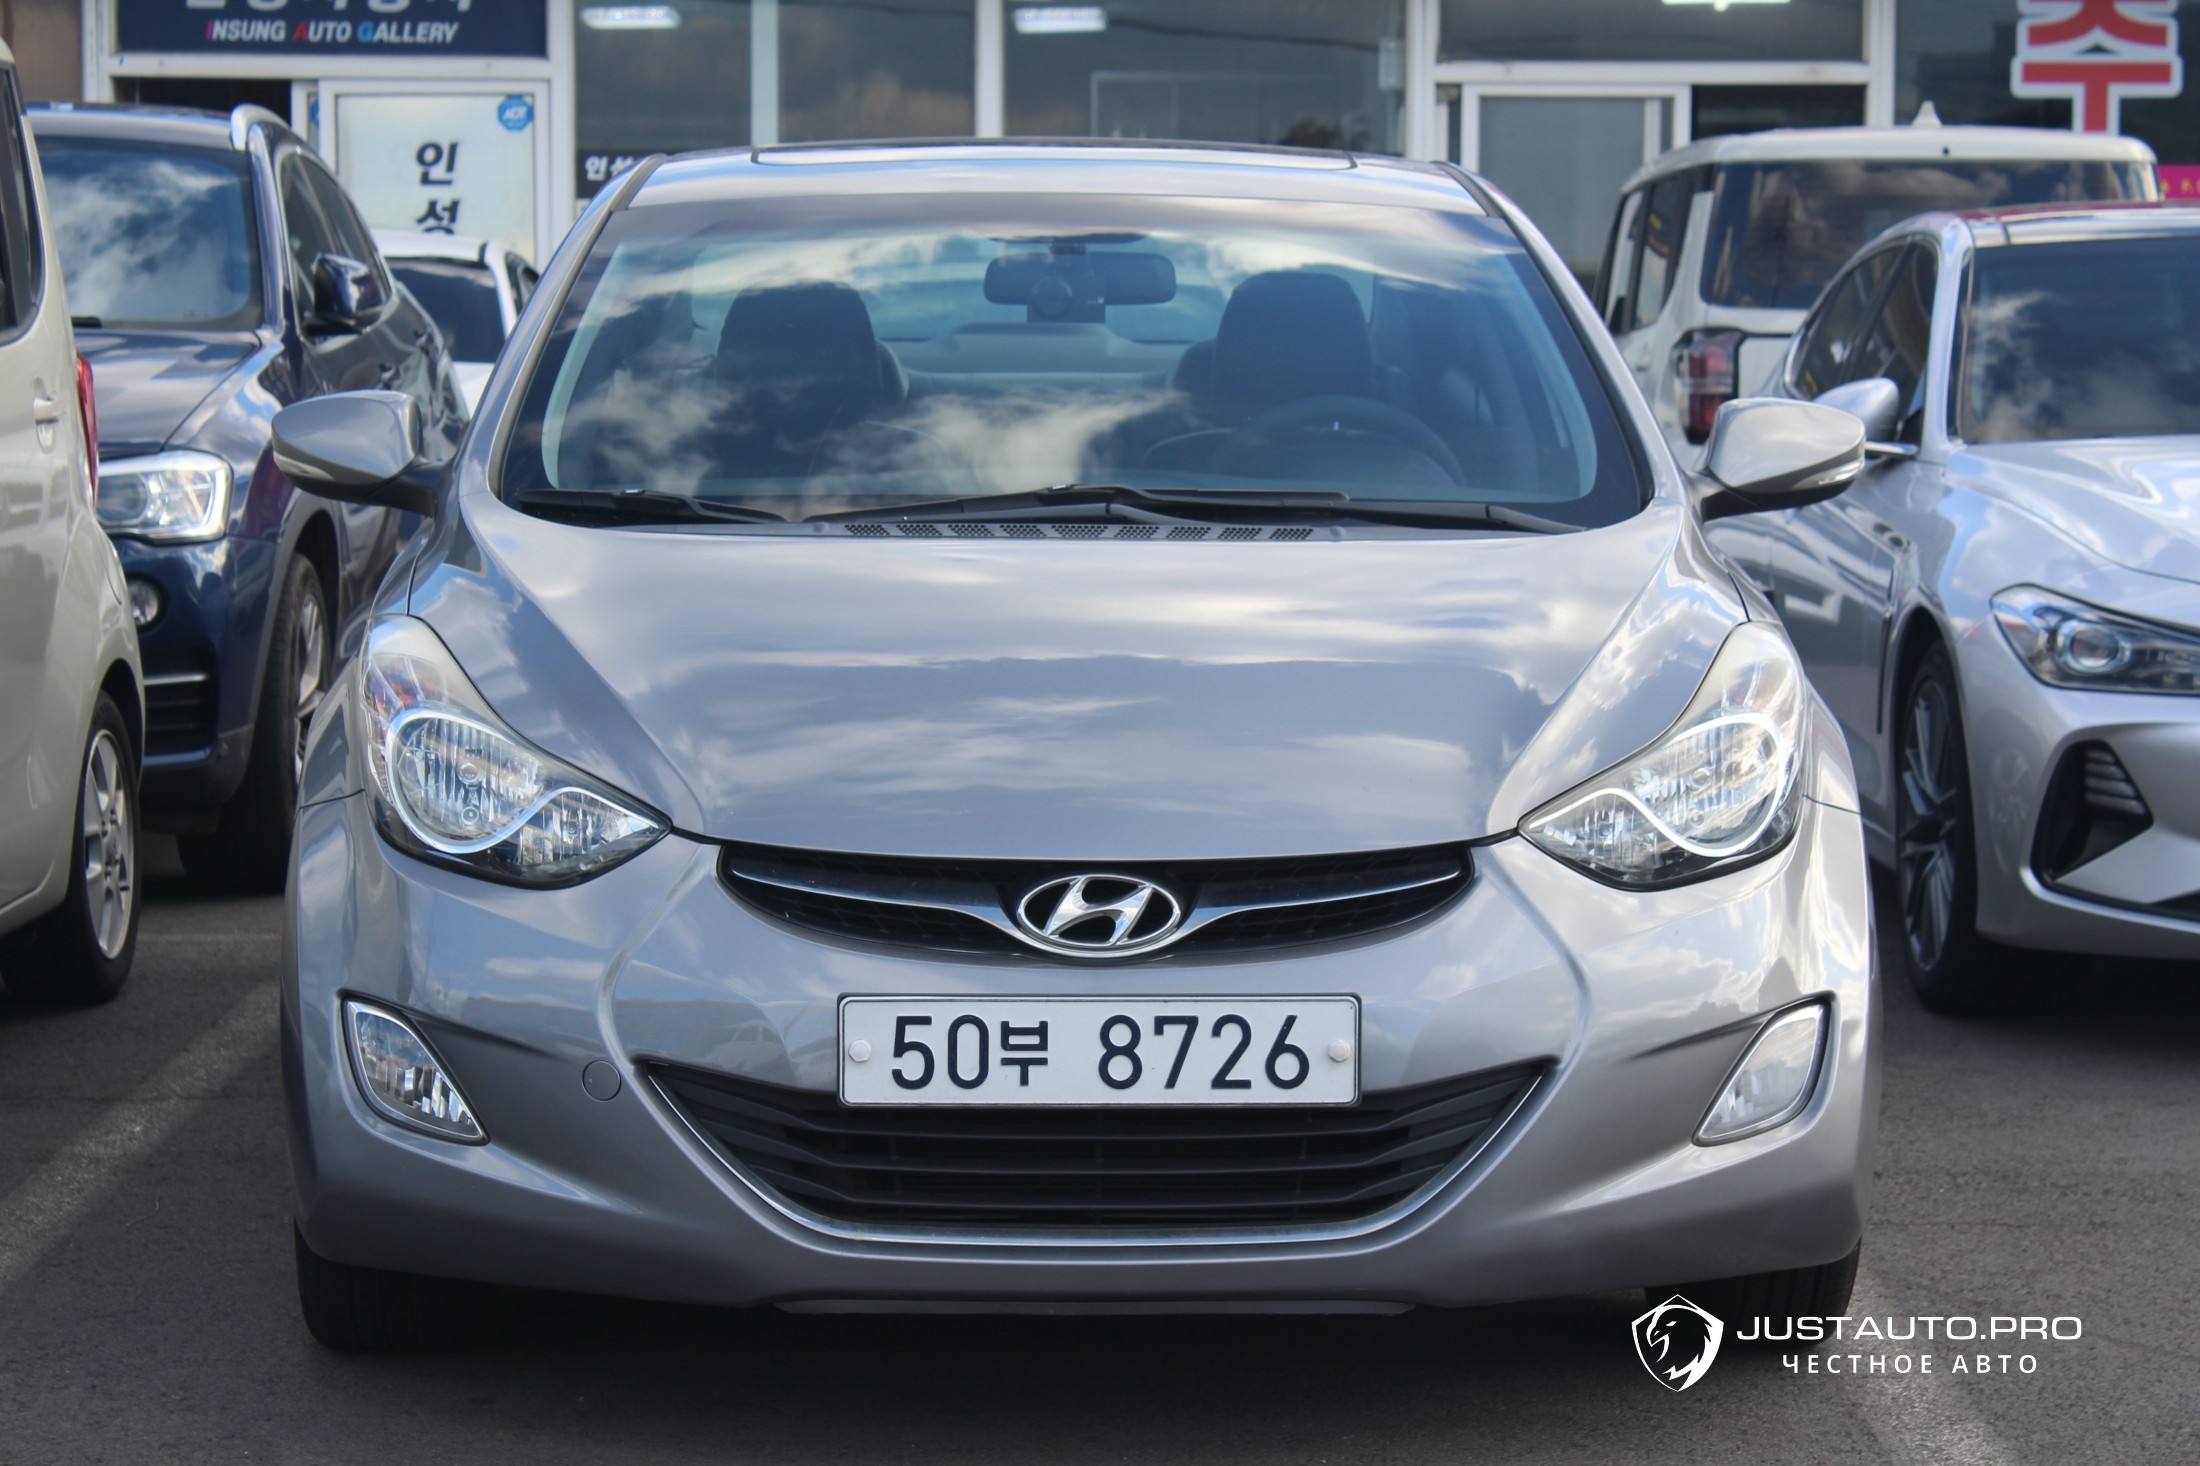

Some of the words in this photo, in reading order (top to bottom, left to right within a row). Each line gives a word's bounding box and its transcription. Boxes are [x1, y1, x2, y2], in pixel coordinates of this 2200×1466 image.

[206, 19, 286, 42] INSUNG
[293, 19, 352, 43] AUTO
[356, 20, 458, 43] GALLERY
[891, 1014, 1049, 1090] 50부
[1098, 1014, 1310, 1090] 8726
